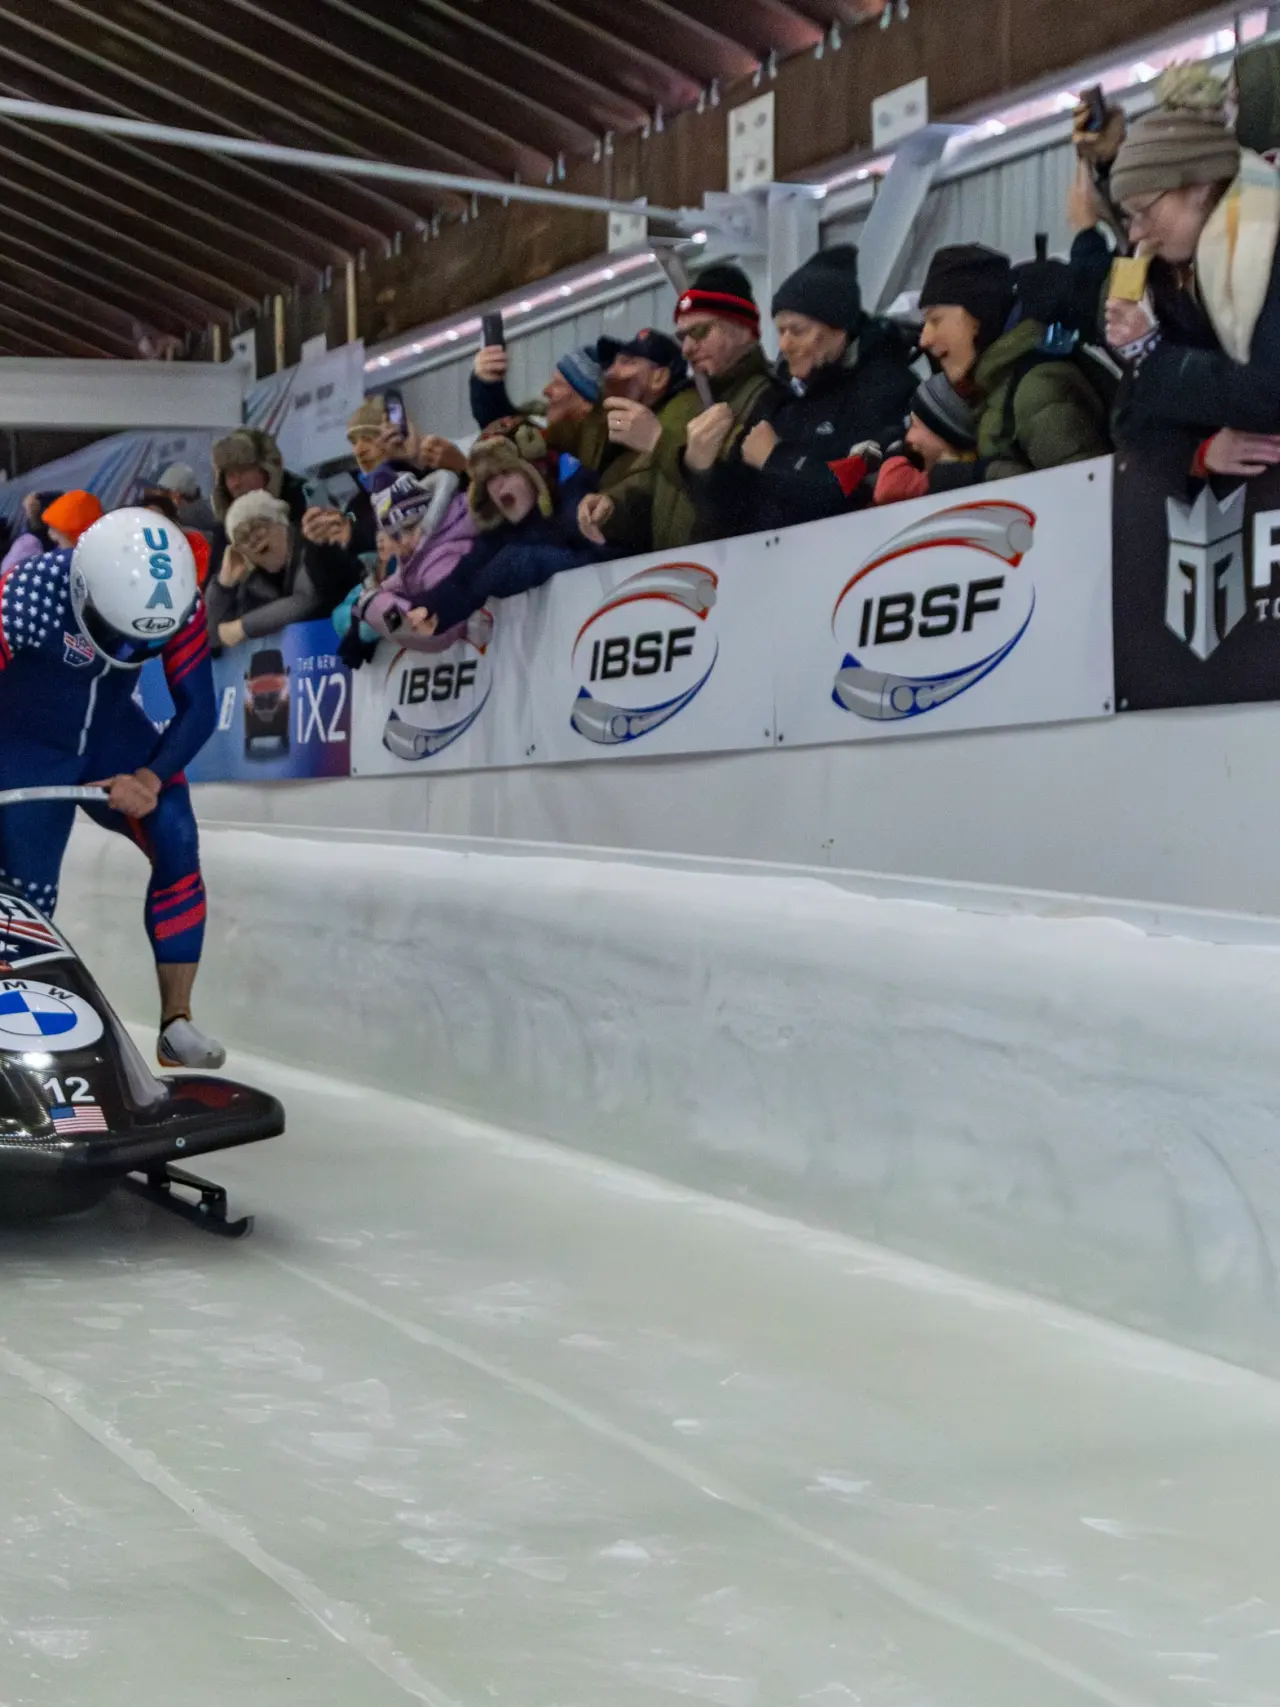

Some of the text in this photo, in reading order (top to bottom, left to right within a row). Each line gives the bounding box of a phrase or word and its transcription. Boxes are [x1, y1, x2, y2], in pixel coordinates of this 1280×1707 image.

[142, 527, 173, 609] USA
[858, 575, 1005, 647] IBSF
[398, 660, 478, 705] IBSF
[589, 626, 696, 682] IBSF
[296, 673, 346, 744] iX2
[43, 1076, 96, 1103] 12
